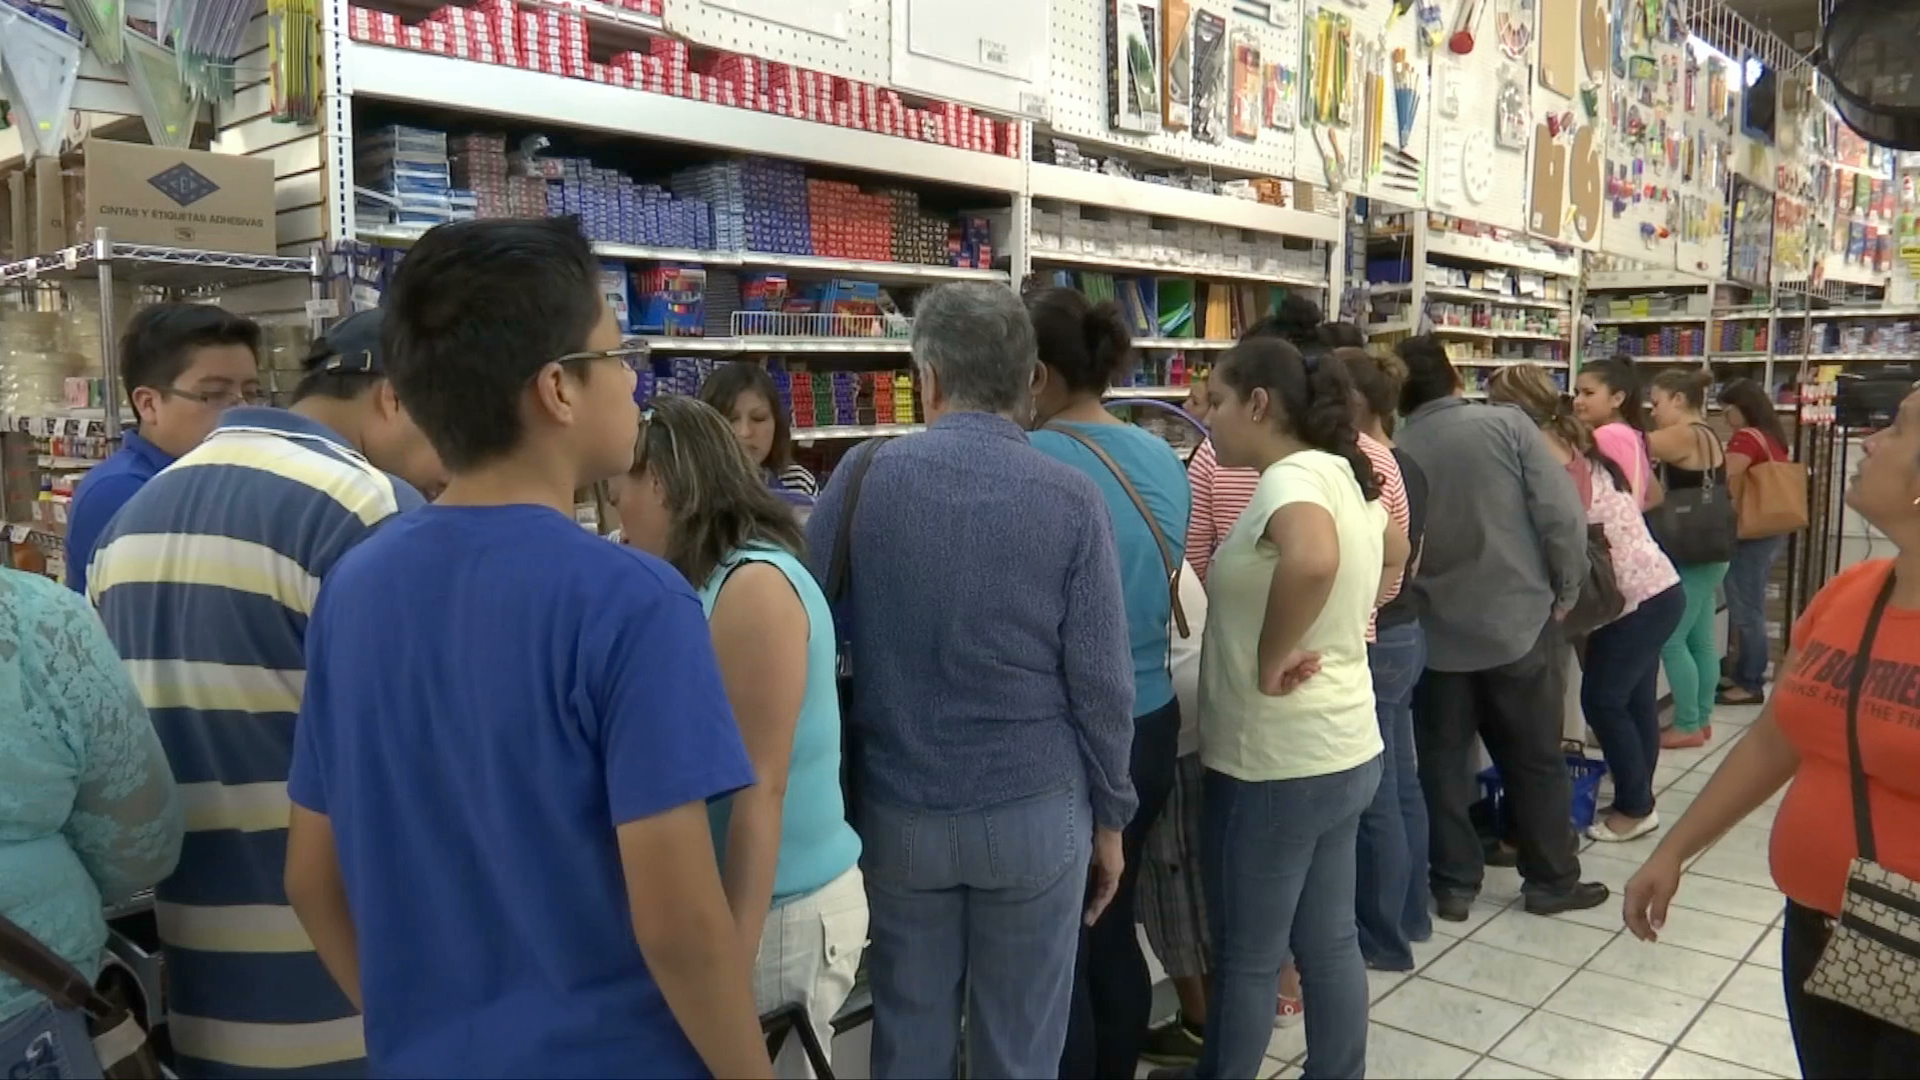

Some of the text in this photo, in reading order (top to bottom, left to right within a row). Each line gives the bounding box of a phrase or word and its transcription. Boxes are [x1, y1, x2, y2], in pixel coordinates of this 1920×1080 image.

[99, 205, 264, 228] CINTAS Y ETIQUETAS ADHESIVAS
